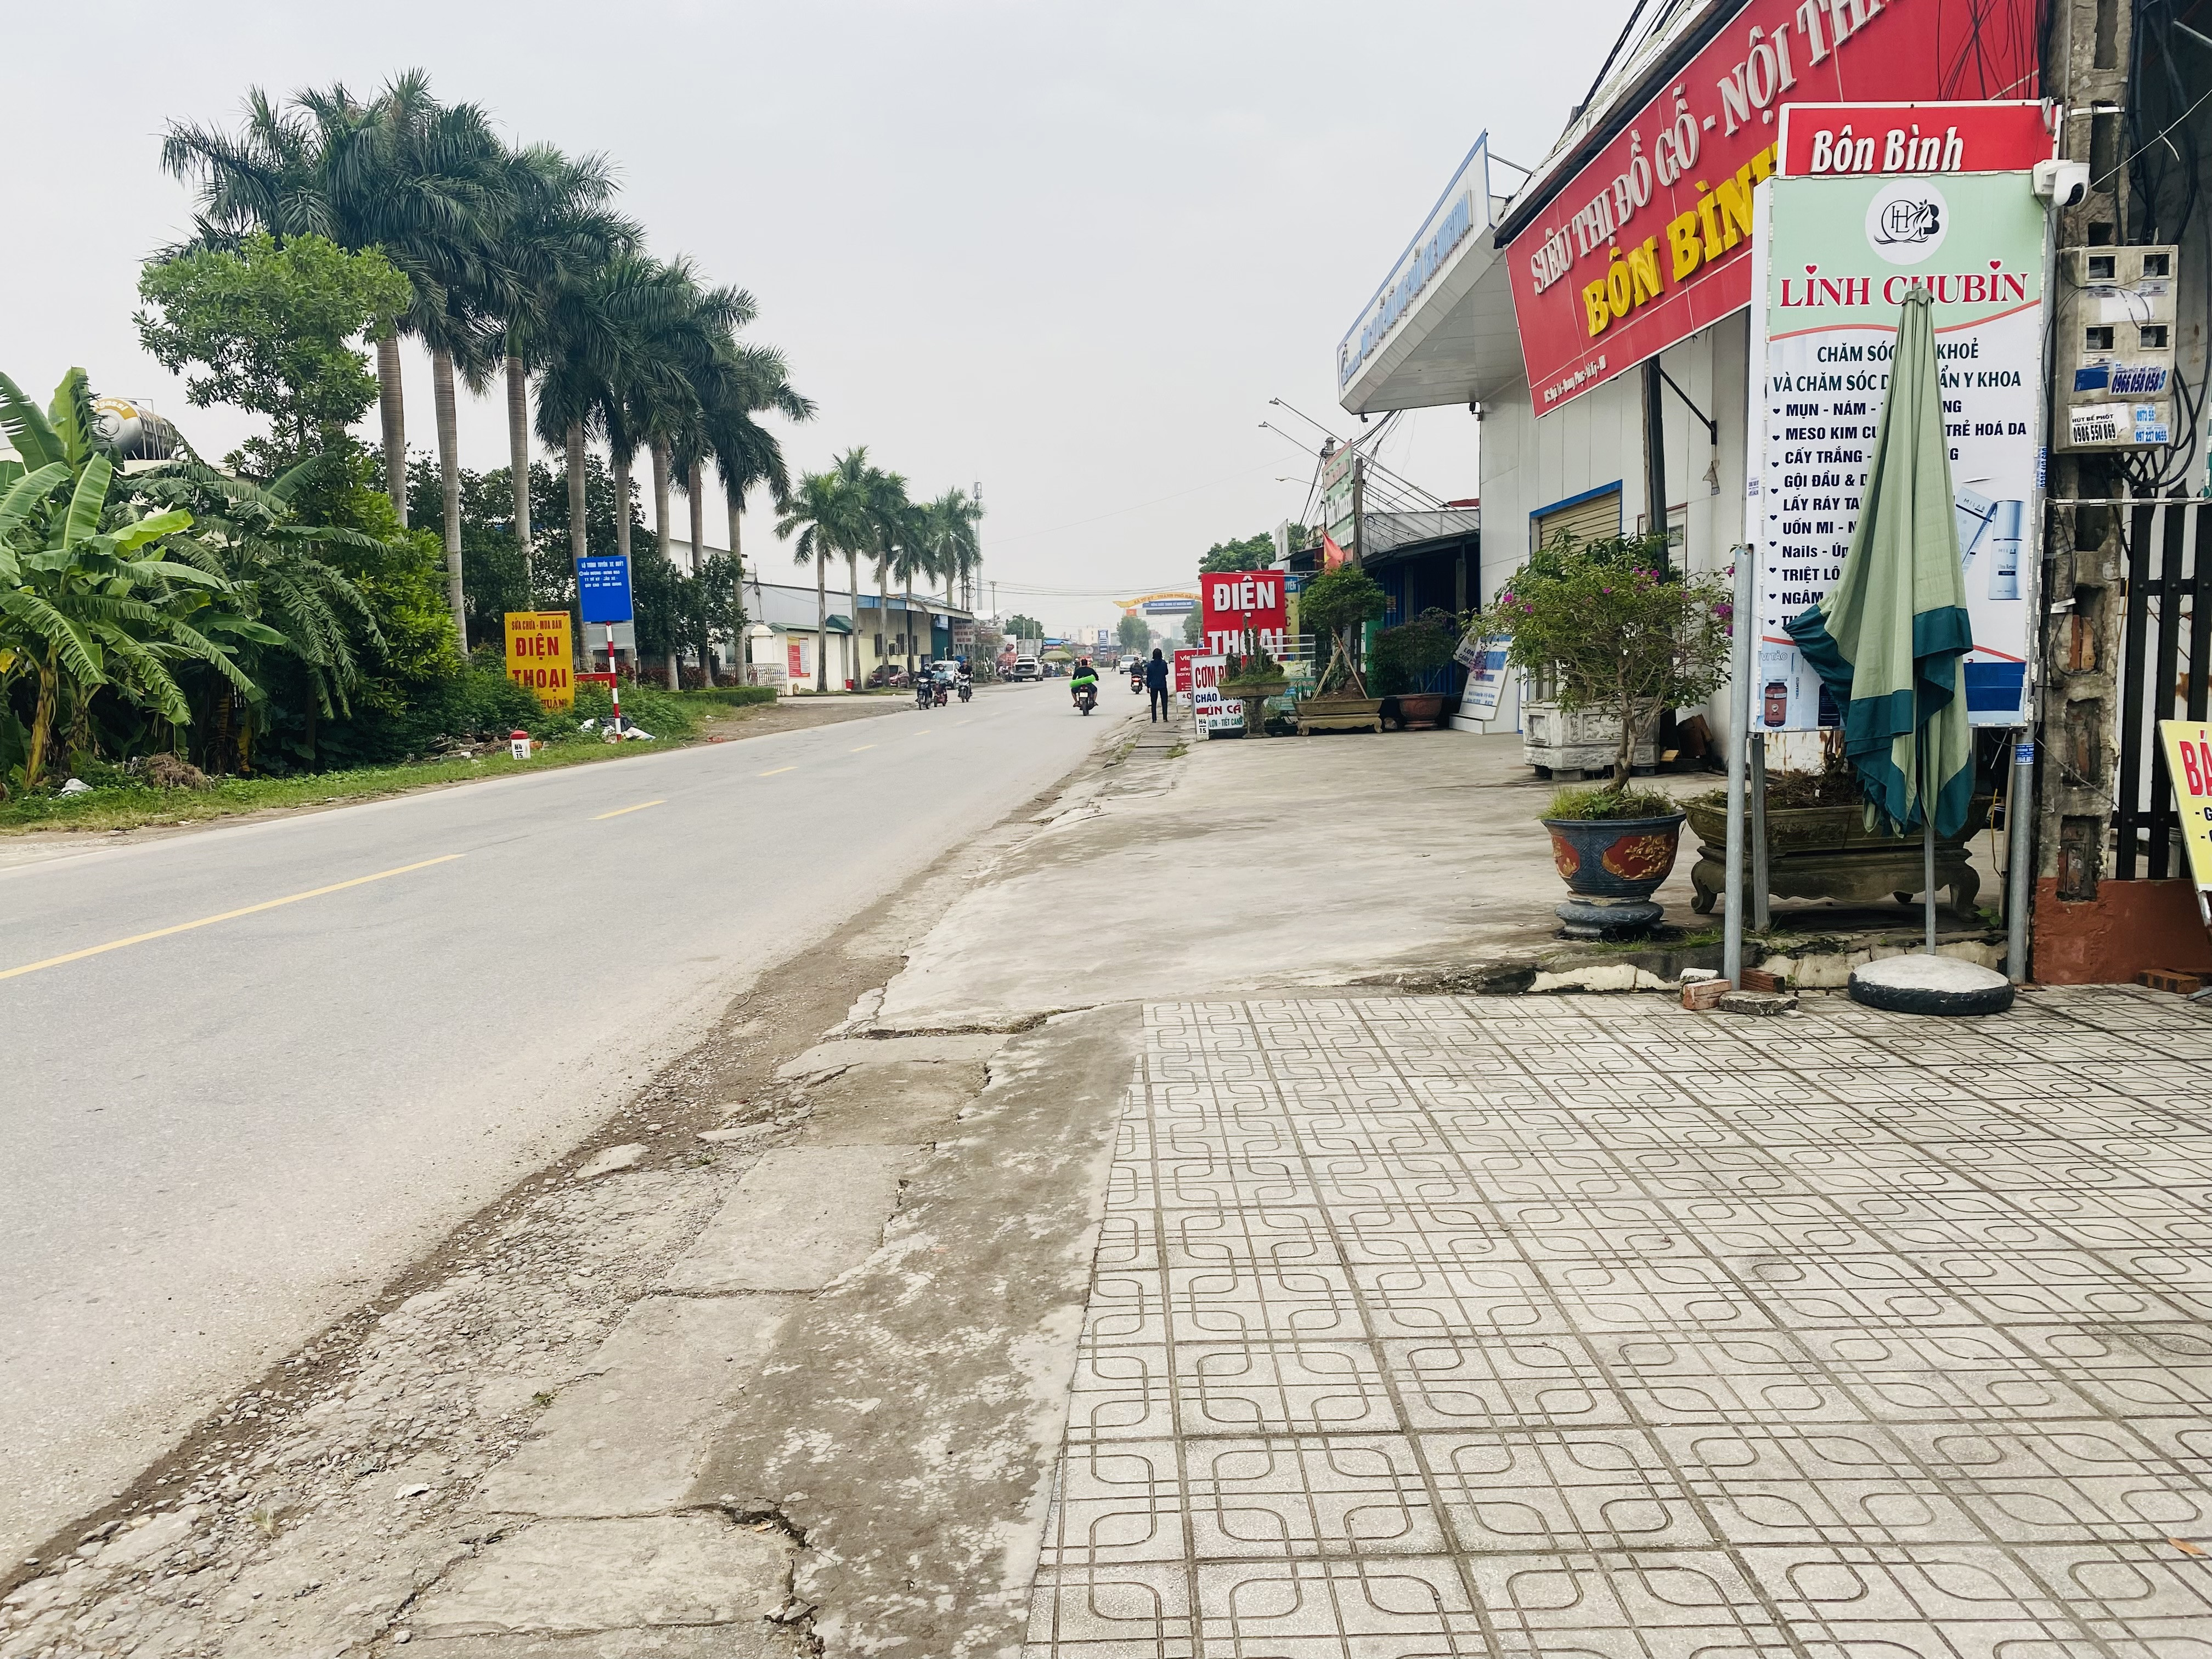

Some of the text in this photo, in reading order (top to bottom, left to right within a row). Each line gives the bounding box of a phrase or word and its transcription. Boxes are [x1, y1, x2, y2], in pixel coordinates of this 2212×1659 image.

[1531, 224, 1574, 296] SIÊU
[1571, 188, 1617, 258] THỊ
[1611, 129, 1653, 227] ĐỒ
[1655, 82, 1700, 187] GỖ
[1717, 22, 1797, 137] NỘI
[1810, 124, 1964, 173] Bôn Bình
[1582, 235, 1664, 338] BÔN
[1818, 342, 1863, 362] CHĂM
[1937, 337, 1979, 359] KHOẺ
[1773, 371, 1793, 392] VÀ
[1797, 372, 1842, 392] CHĂM
[1846, 370, 1877, 391] SÓC
[1964, 372, 1974, 388] Y
[1978, 371, 2022, 387] KHOA
[1786, 400, 1866, 419] MỤN NÁM
[1786, 427, 1826, 441] MESO
[1830, 427, 1858, 439] KIM
[1945, 419, 1971, 437] TRẺ
[1975, 420, 2004, 436] HOÁ
[2008, 422, 2027, 435] DA
[1785, 446, 1863, 464] CẤY TRẮNG
[1784, 472, 1807, 490] GỘI
[1812, 470, 1839, 487] ĐẦU
[1784, 494, 1862, 511] LẤY RÁY TA
[1783, 517, 1811, 534] UỐN
[1816, 522, 1833, 534] MI
[1782, 545, 1818, 558] Nails
[1782, 566, 1819, 583] TRIỆT
[1213, 575, 1276, 617] ĐIỆN
[1782, 590, 1824, 605] NGÂM
[516, 633, 559, 661] ĐIỆN
[512, 668, 567, 692] THOẠI
[1195, 665, 1216, 689] CƠM
[1195, 692, 1217, 703] CHÁO
[1207, 704, 1222, 715] ÚN
